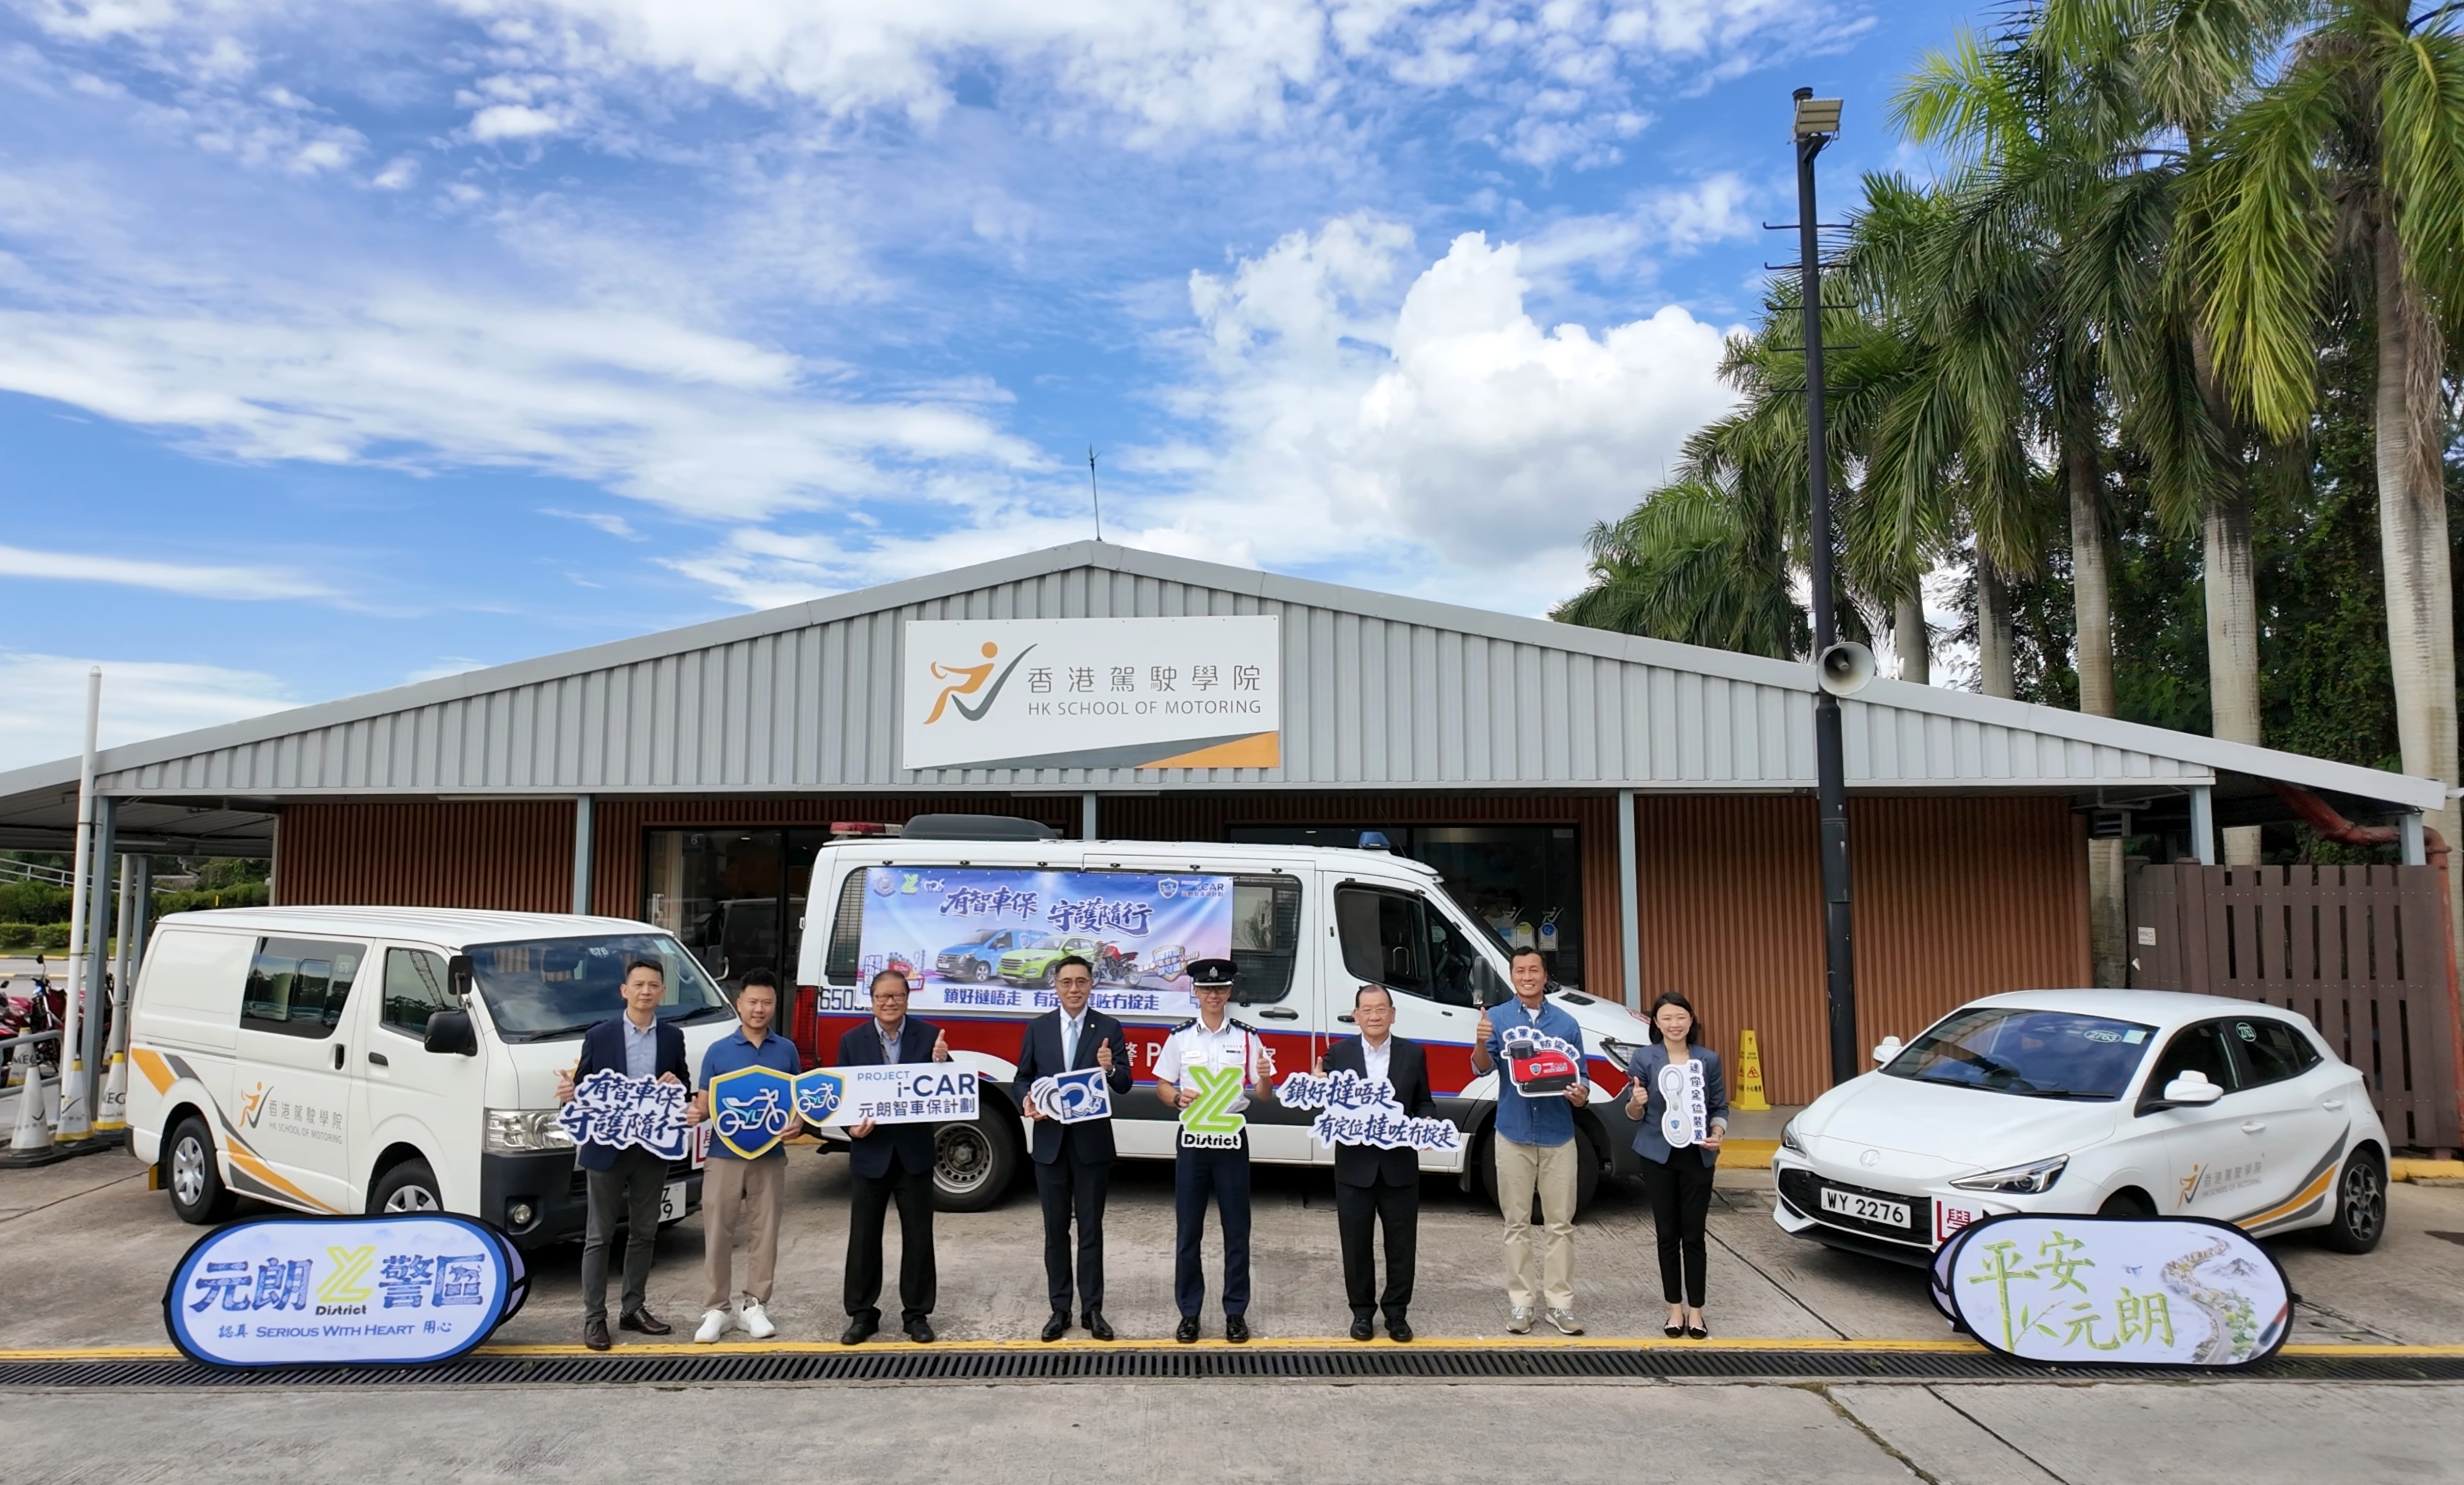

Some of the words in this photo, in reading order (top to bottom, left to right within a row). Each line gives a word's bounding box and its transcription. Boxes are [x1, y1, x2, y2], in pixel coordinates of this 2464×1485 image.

[1028, 664, 1261, 693] 香港駕駛學院
[1029, 701, 1051, 716] HK
[1058, 701, 1129, 716] SCHOOL
[1135, 701, 1157, 715] OF
[1165, 699, 1261, 715] MOTORING
[940, 886, 1039, 919] 有智車保
[1047, 897, 1154, 937] 守護隨行
[819, 988, 873, 1011] 650
[857, 1070, 910, 1081] PROJECT
[897, 1073, 976, 1098] i-CAR
[578, 1072, 683, 1112] 有智車保
[1283, 1074, 1398, 1110] 鎖好撻唔走
[269, 1099, 343, 1130] 香港駕駛學院
[859, 1097, 975, 1118] 元朗智車保計劃
[269, 1122, 277, 1130] HK
[278, 1123, 301, 1136] SCHOOL
[302, 1127, 309, 1137] OF
[311, 1130, 343, 1145] MOTORING
[560, 1100, 693, 1156] 守護隨行
[1184, 1133, 1239, 1147] District
[1314, 1113, 1460, 1148] 有定位撻咗冇掟走
[1828, 1192, 1849, 1211] WY
[1855, 1198, 1904, 1224] 2276
[189, 1257, 314, 1313] 元朗
[379, 1253, 486, 1309] 警區
[1968, 1231, 2096, 1353] 平安
[315, 1304, 367, 1317] District
[2062, 1286, 2174, 1351] 元朗
[218, 1324, 249, 1338] 認真
[256, 1325, 321, 1338] SERIOUS
[323, 1325, 362, 1336] WITH
[364, 1324, 415, 1336] HEART
[423, 1322, 452, 1335] 用心
